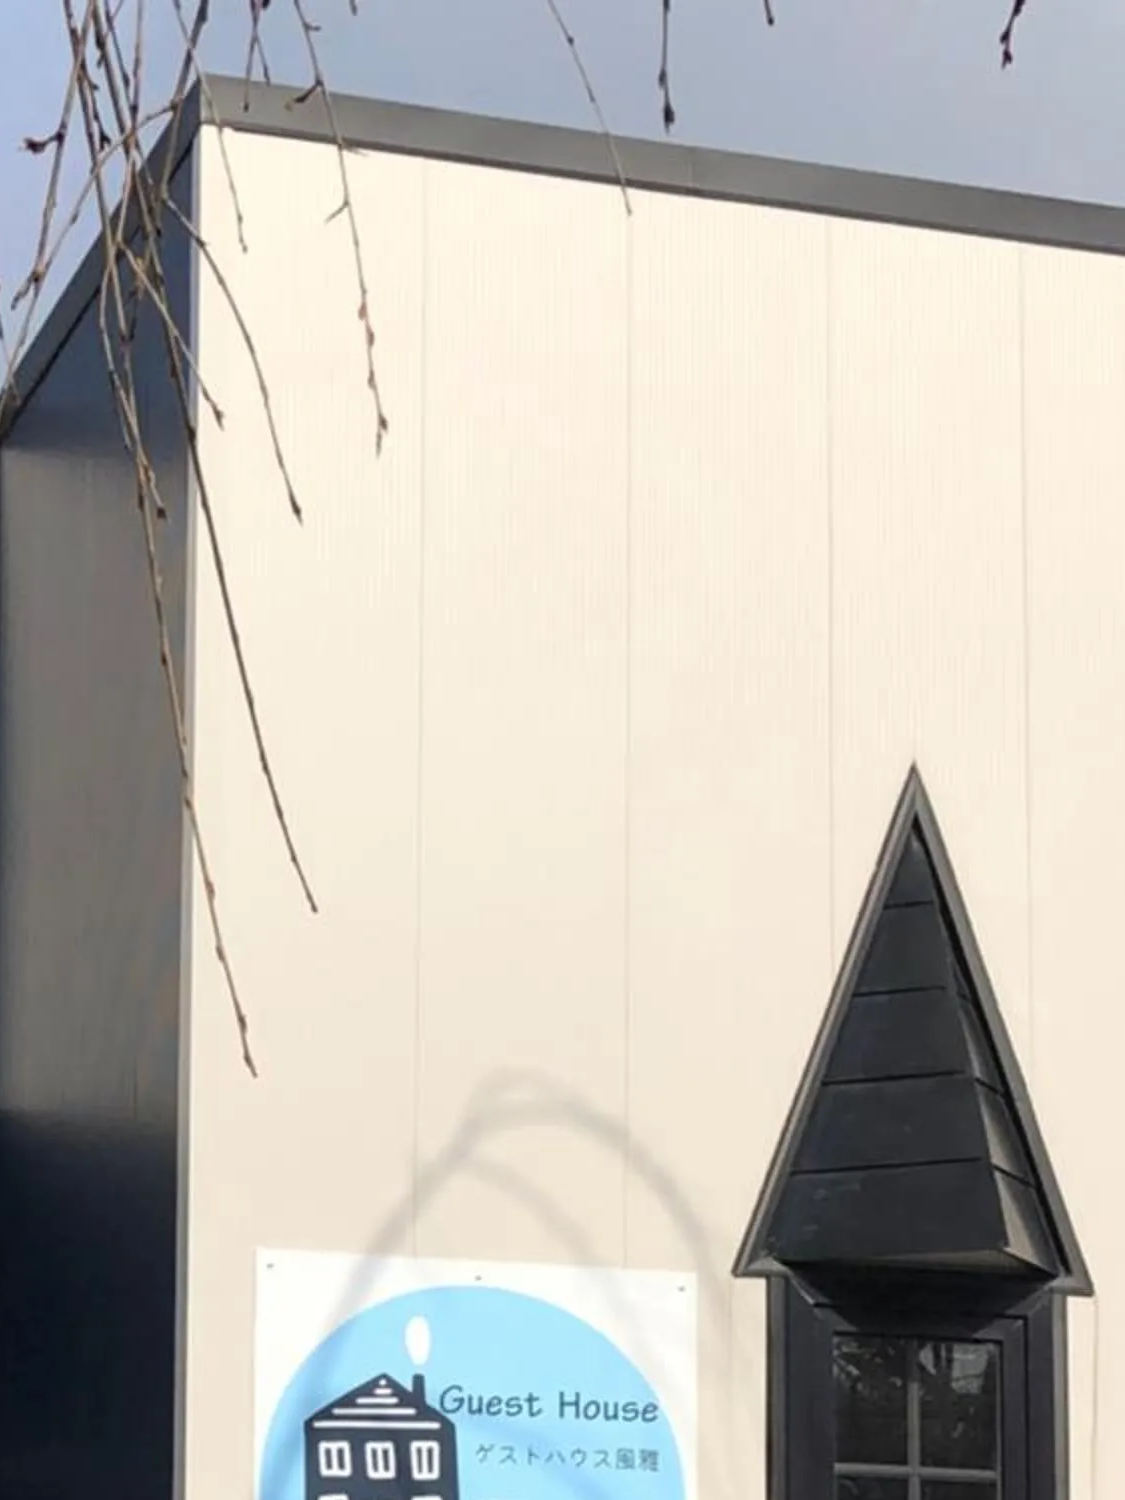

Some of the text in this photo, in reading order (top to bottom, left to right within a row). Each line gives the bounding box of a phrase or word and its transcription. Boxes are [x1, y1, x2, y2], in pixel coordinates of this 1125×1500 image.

[439, 1384, 659, 1423] Guest House
[475, 1443, 660, 1473] ゲストハウス風雅
